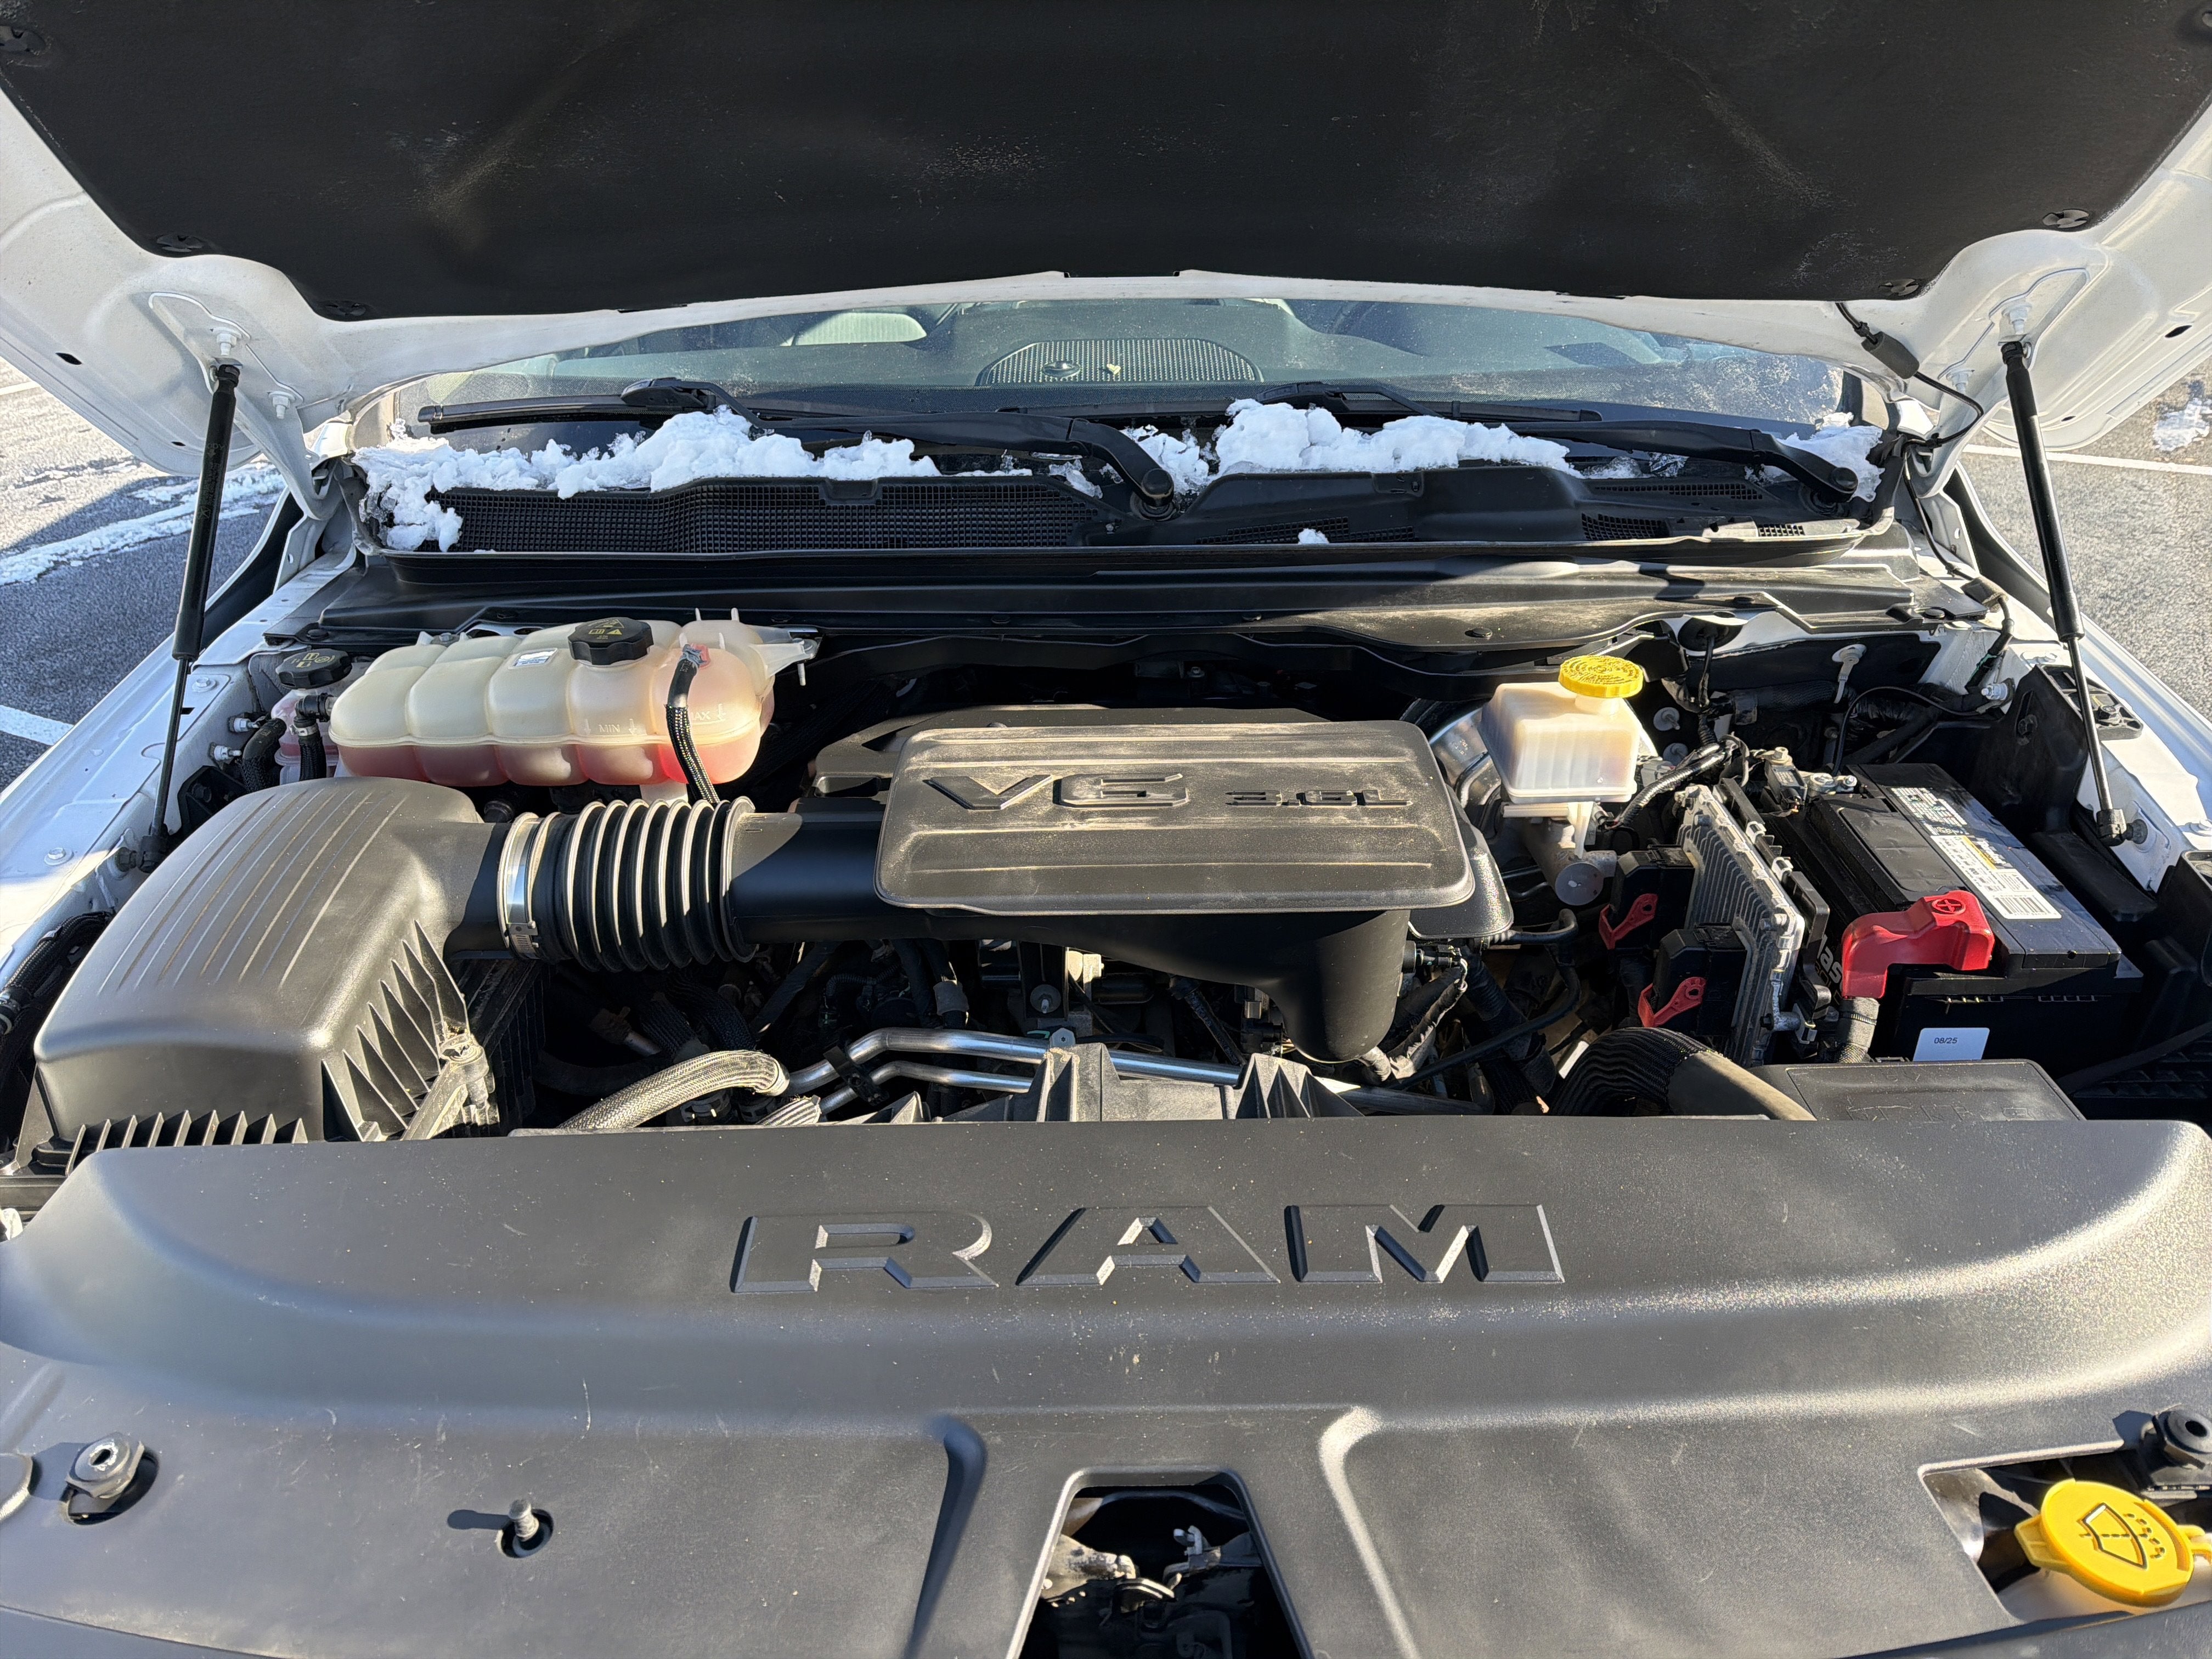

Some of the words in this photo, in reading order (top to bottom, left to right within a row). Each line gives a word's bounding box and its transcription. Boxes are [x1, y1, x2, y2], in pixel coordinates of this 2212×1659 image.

[598, 724, 620, 733] MIN
[924, 773, 1189, 810] V6
[1226, 790, 1413, 806] 3.6L
[730, 1204, 1565, 1293] RAM
